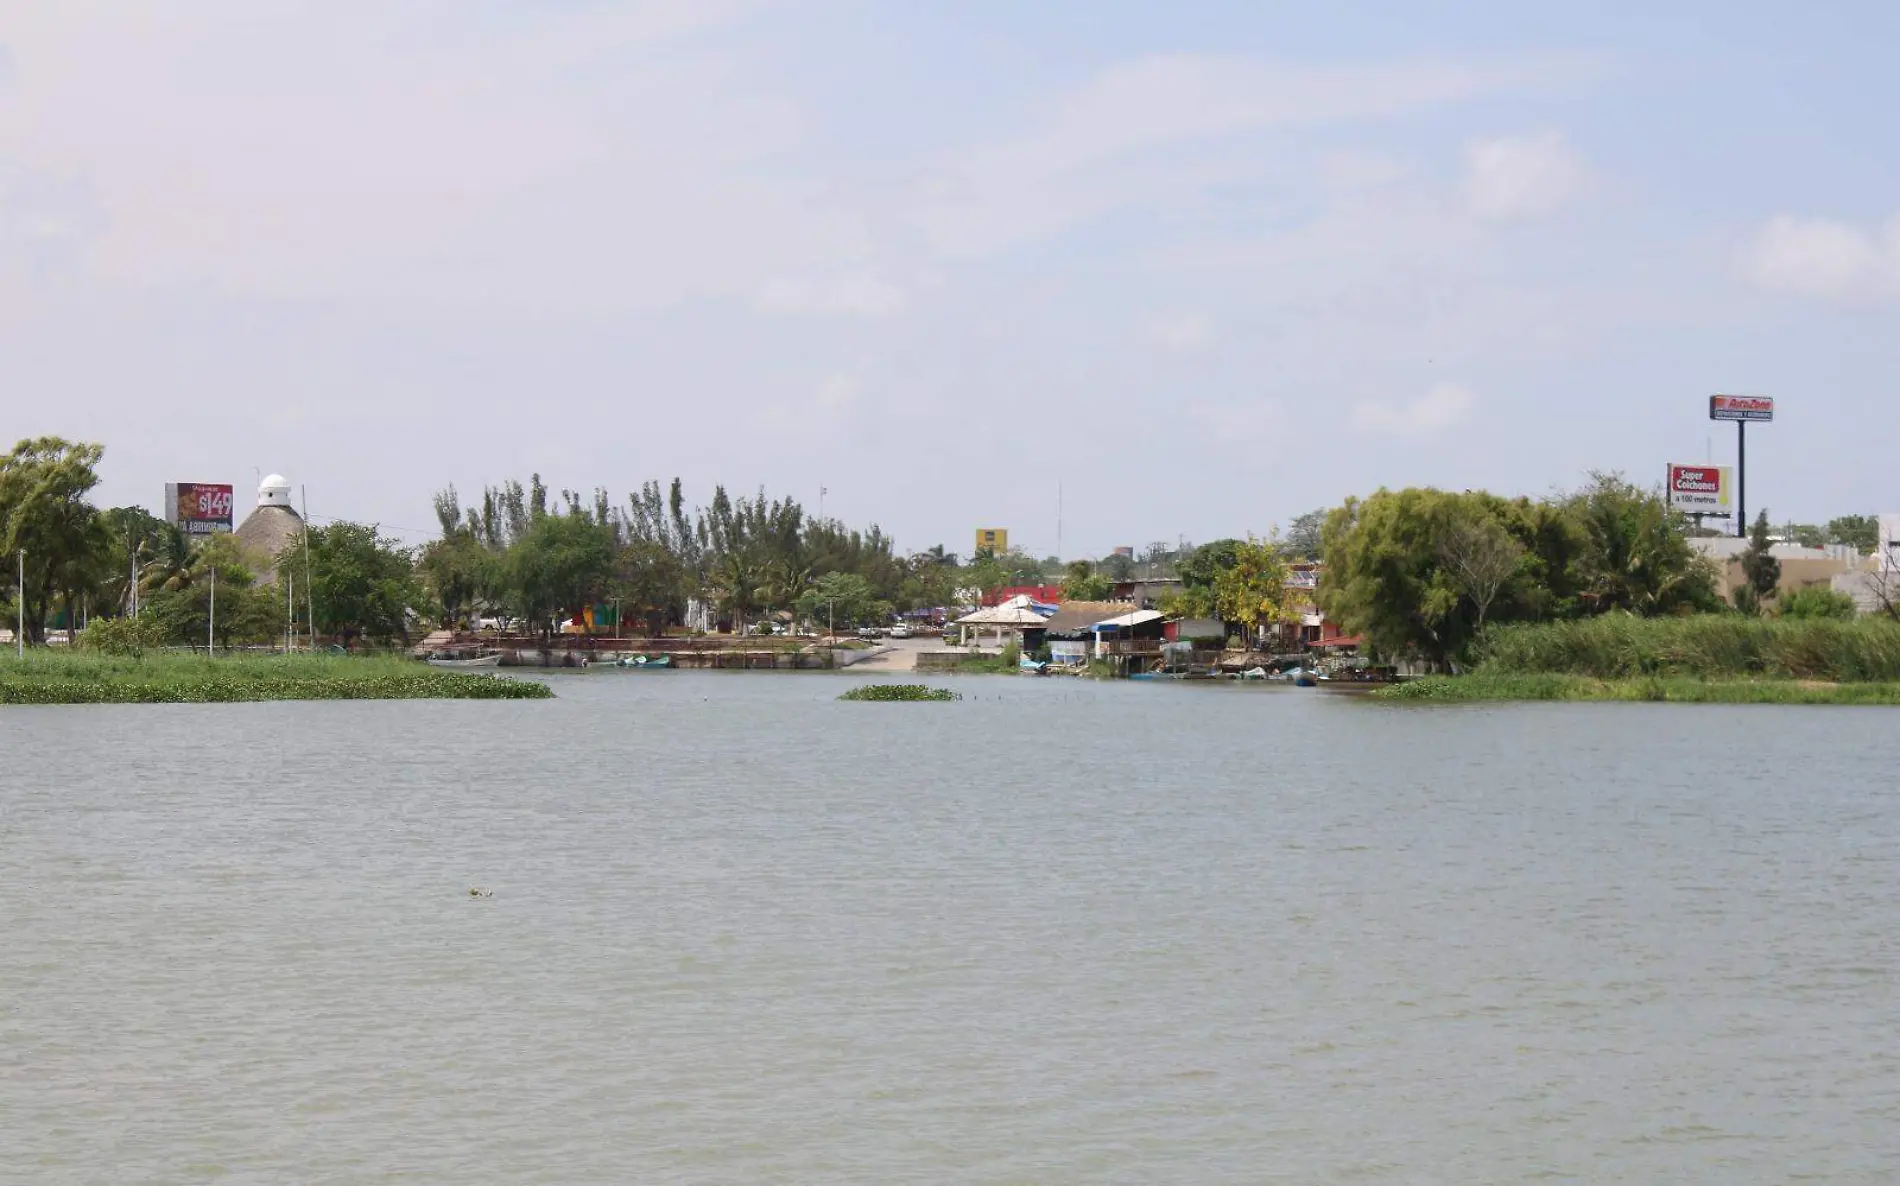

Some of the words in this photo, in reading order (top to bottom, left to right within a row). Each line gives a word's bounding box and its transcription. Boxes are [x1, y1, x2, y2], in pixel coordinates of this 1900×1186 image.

[1681, 469, 1704, 480] Super
[1677, 480, 1716, 490] Colchones
[199, 492, 233, 515] $149
[1694, 496, 1717, 504] metros
